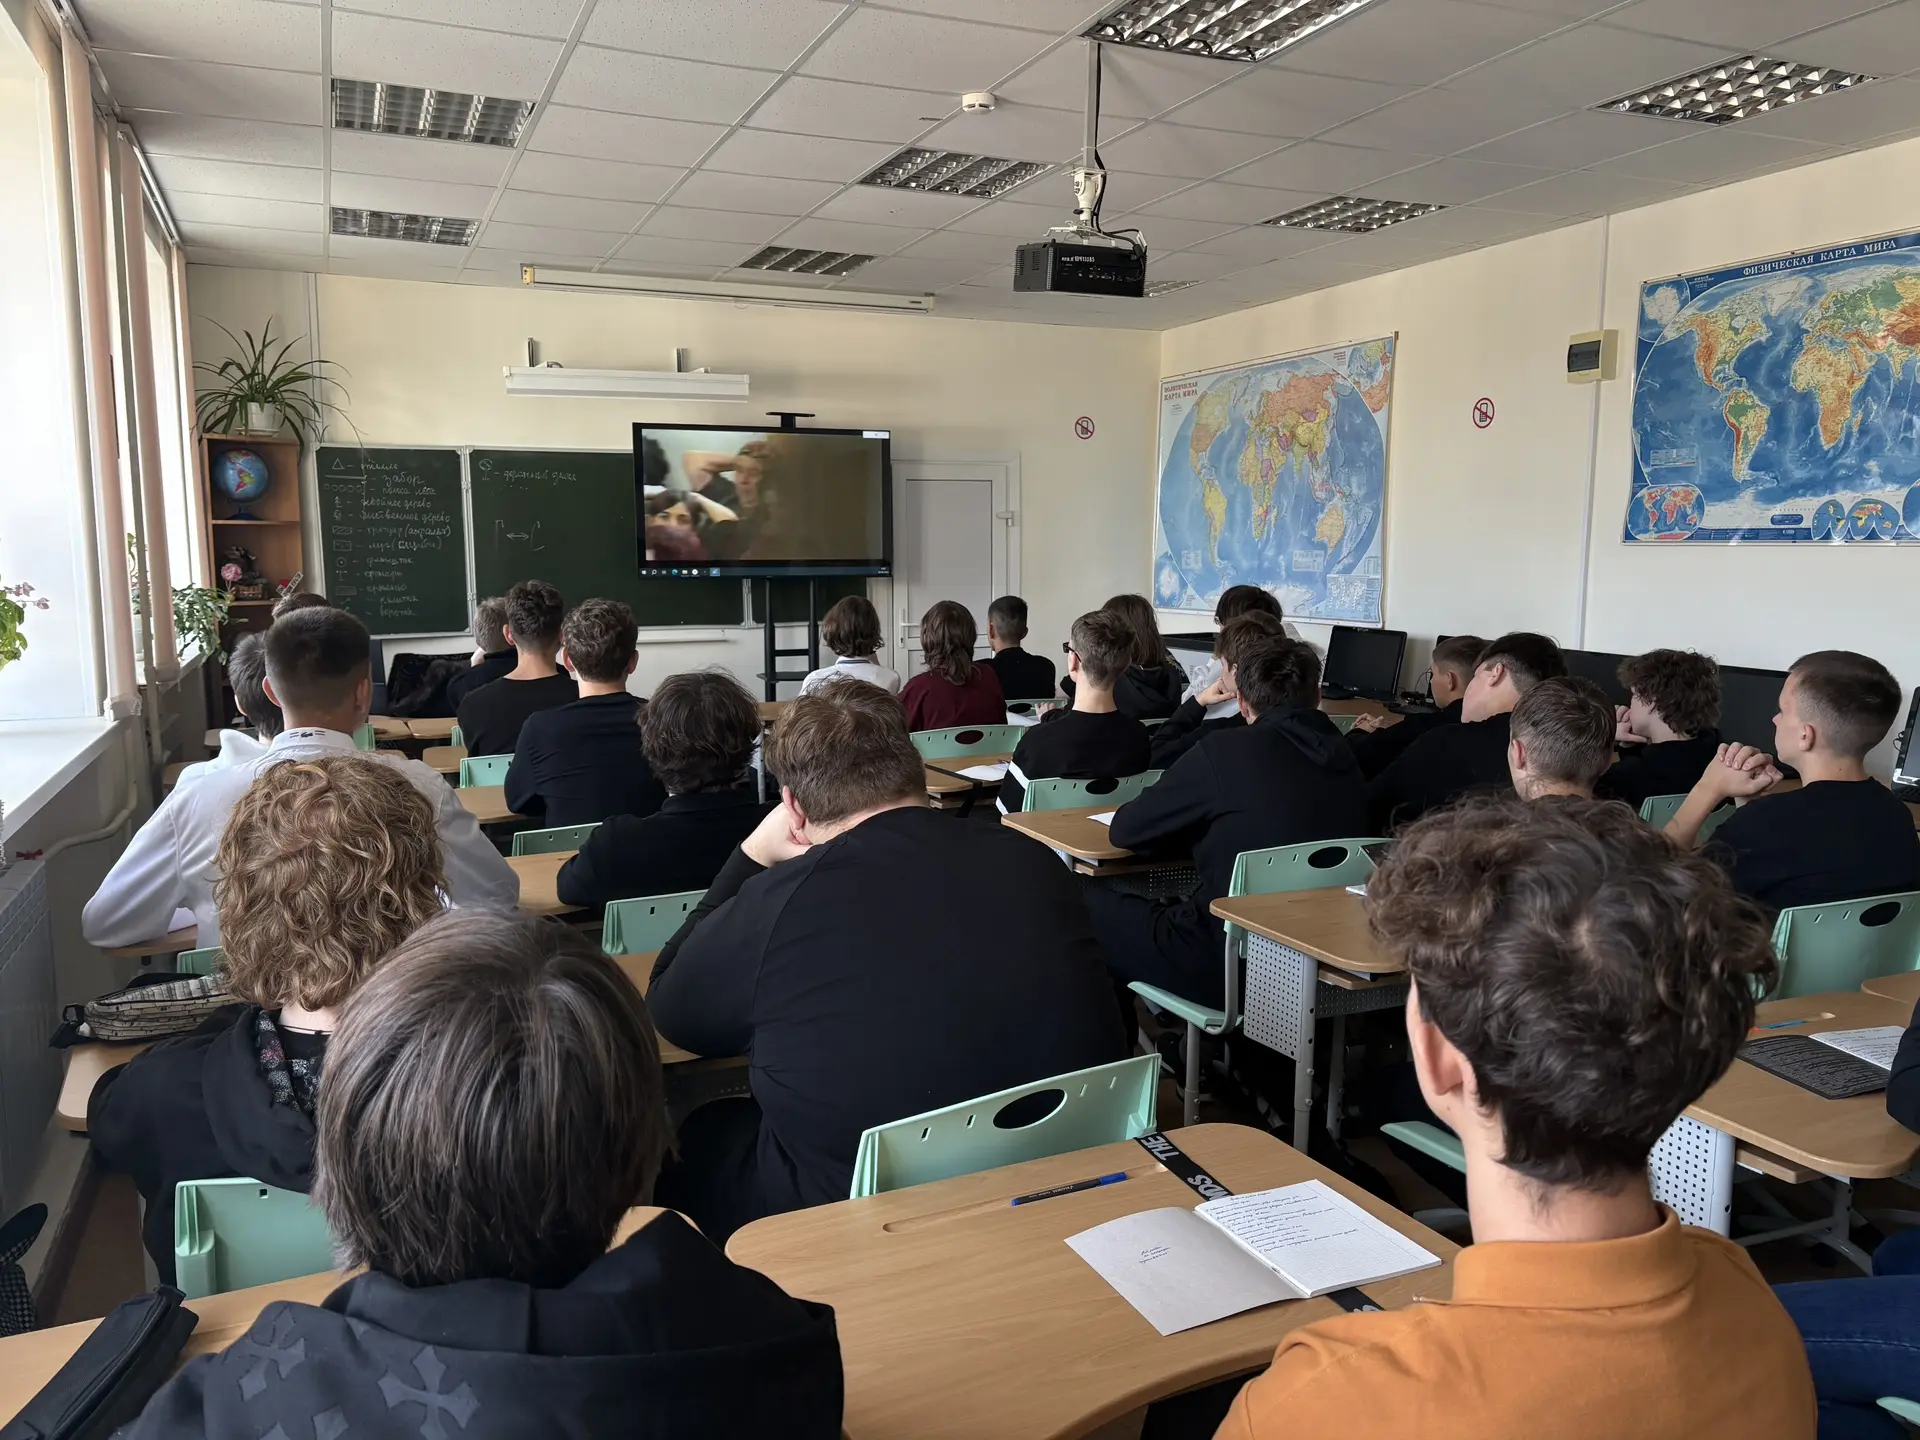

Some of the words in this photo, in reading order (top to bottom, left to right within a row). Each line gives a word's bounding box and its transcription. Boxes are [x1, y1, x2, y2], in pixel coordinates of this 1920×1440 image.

[1743, 255, 1814, 275] ФИЗИЧЕСКАЯ
[1820, 247, 1857, 261] КАРТА
[1864, 240, 1897, 254] МИРА
[1164, 392, 1182, 401] КАРТА
[1182, 389, 1198, 398] МИРА
[381, 471, 425, 488] забор
[1141, 1136, 1180, 1161] THE
